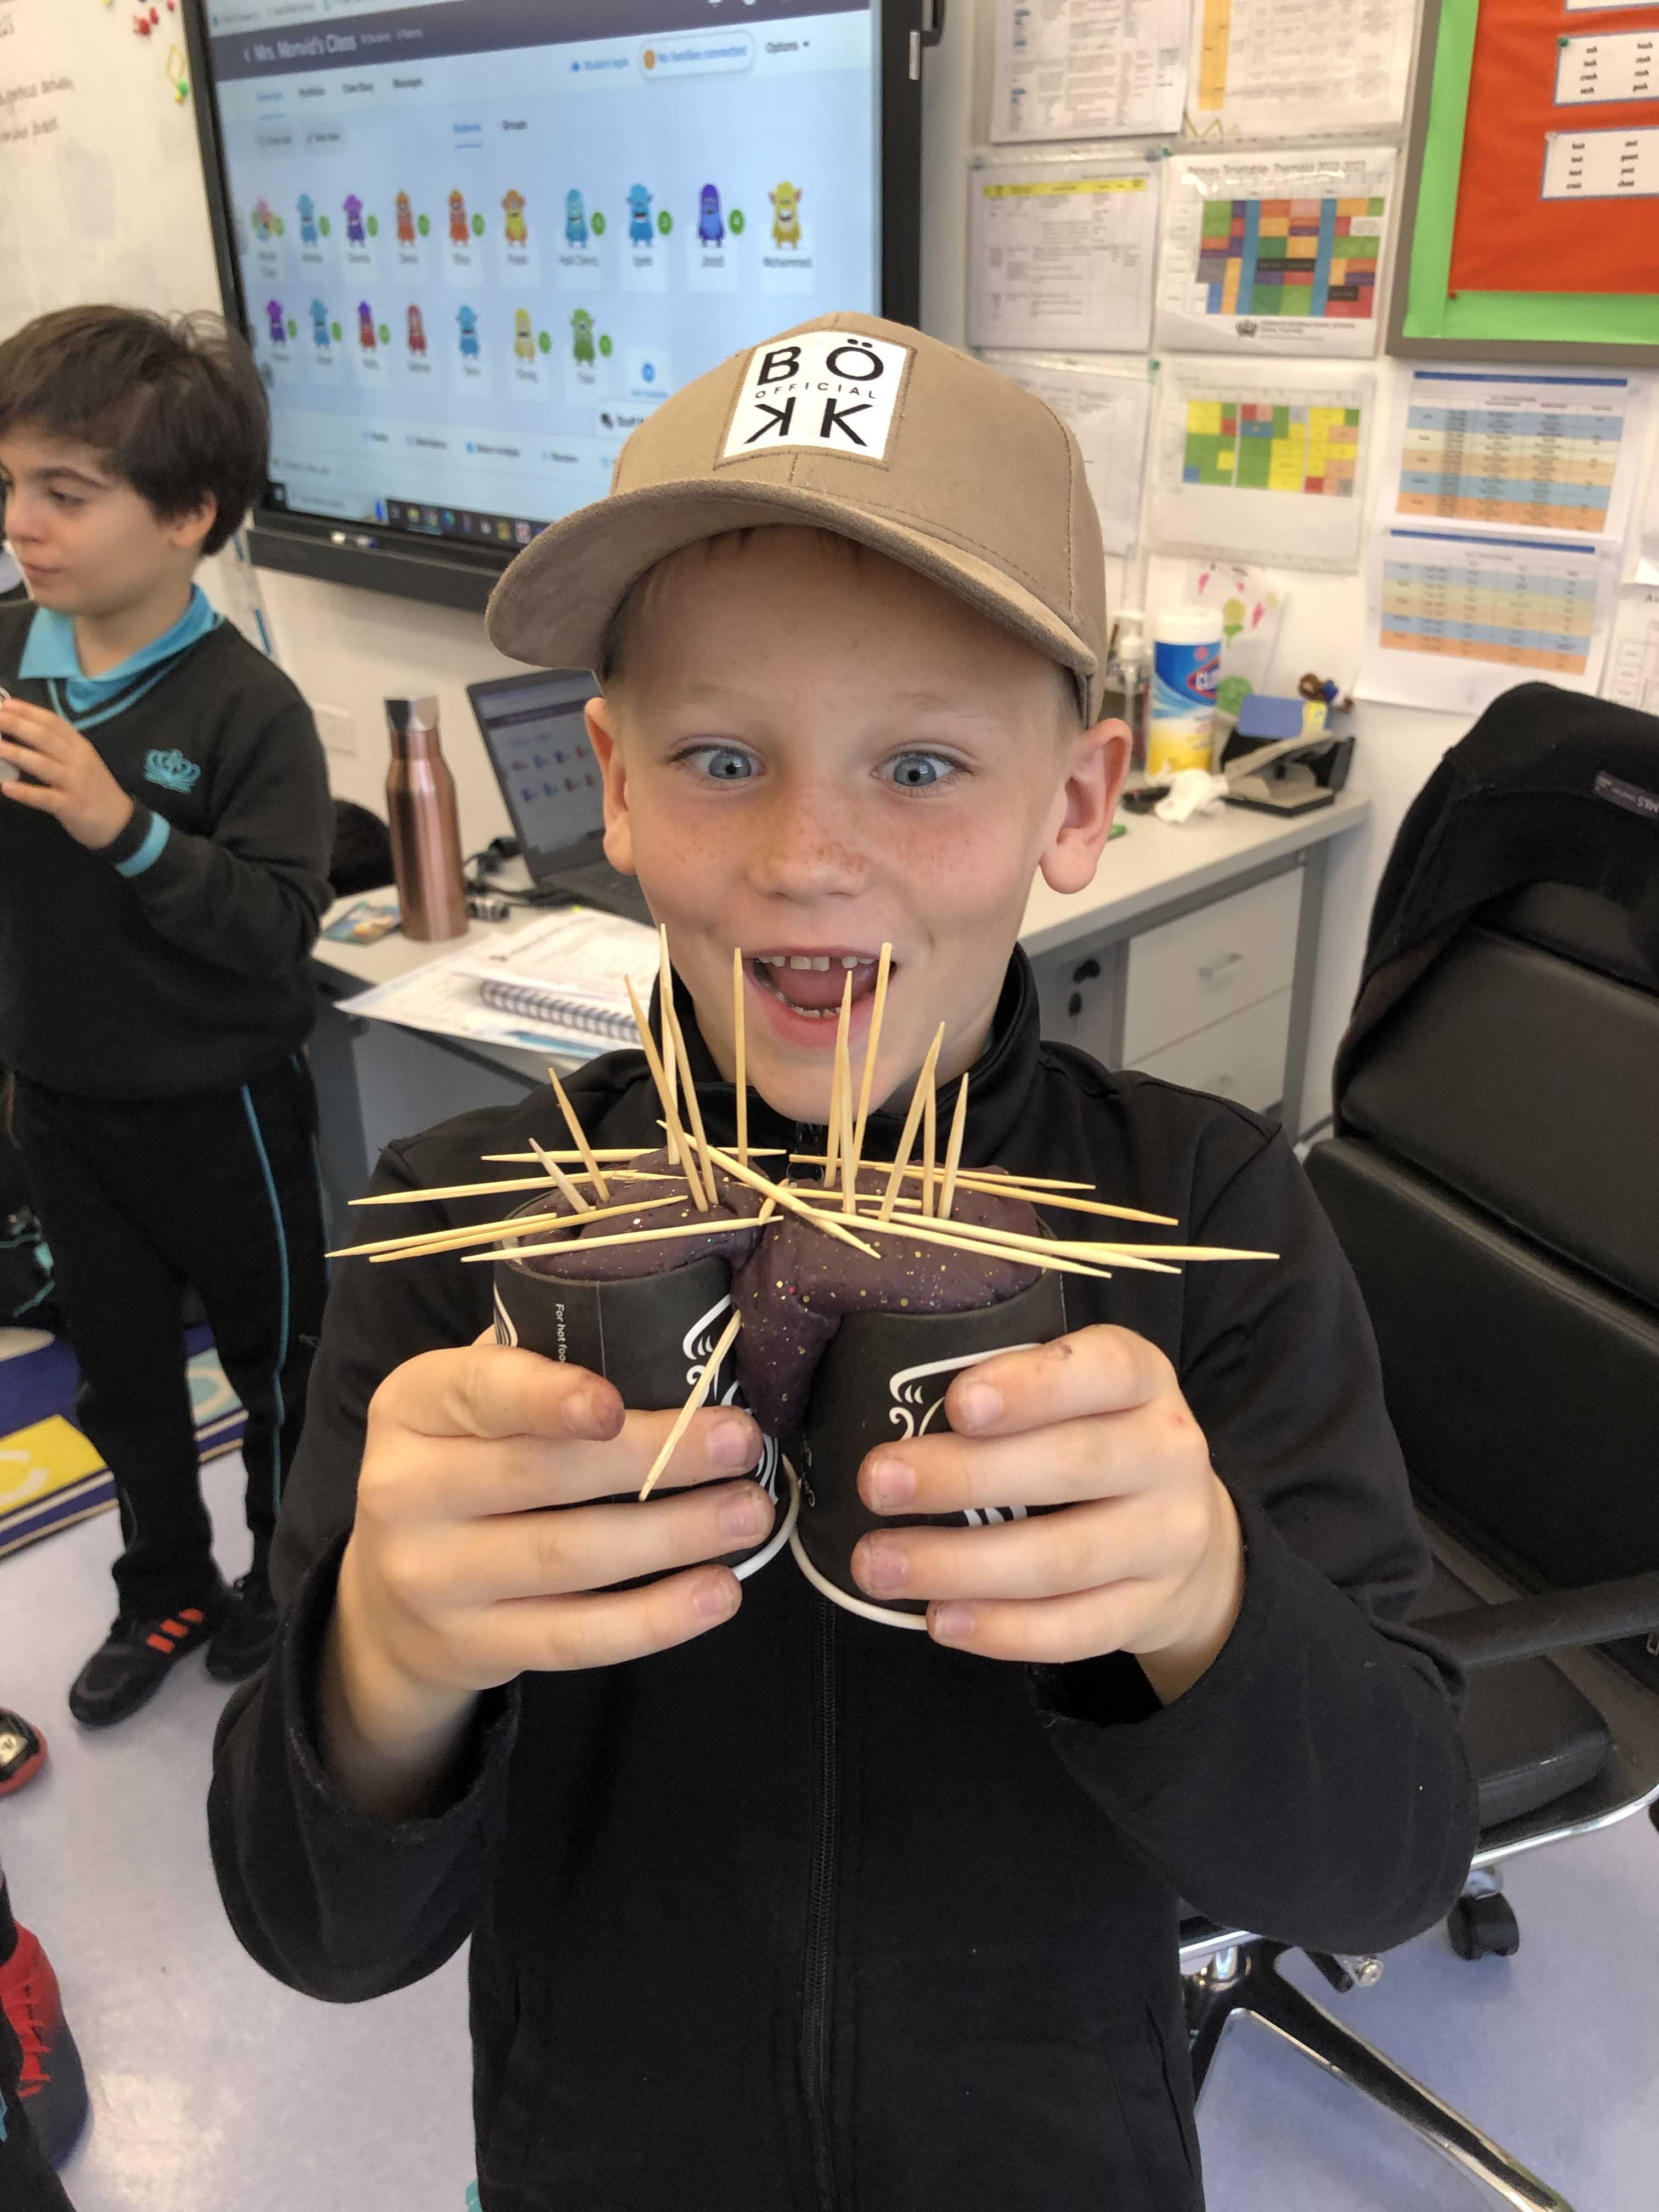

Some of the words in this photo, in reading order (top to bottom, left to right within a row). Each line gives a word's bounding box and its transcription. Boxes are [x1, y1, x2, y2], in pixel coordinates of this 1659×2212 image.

[755, 382, 876, 399] OFFICIAL
[555, 1304, 565, 1322] For
[557, 1324, 566, 1342] hot
[558, 1344, 568, 1363] foo
